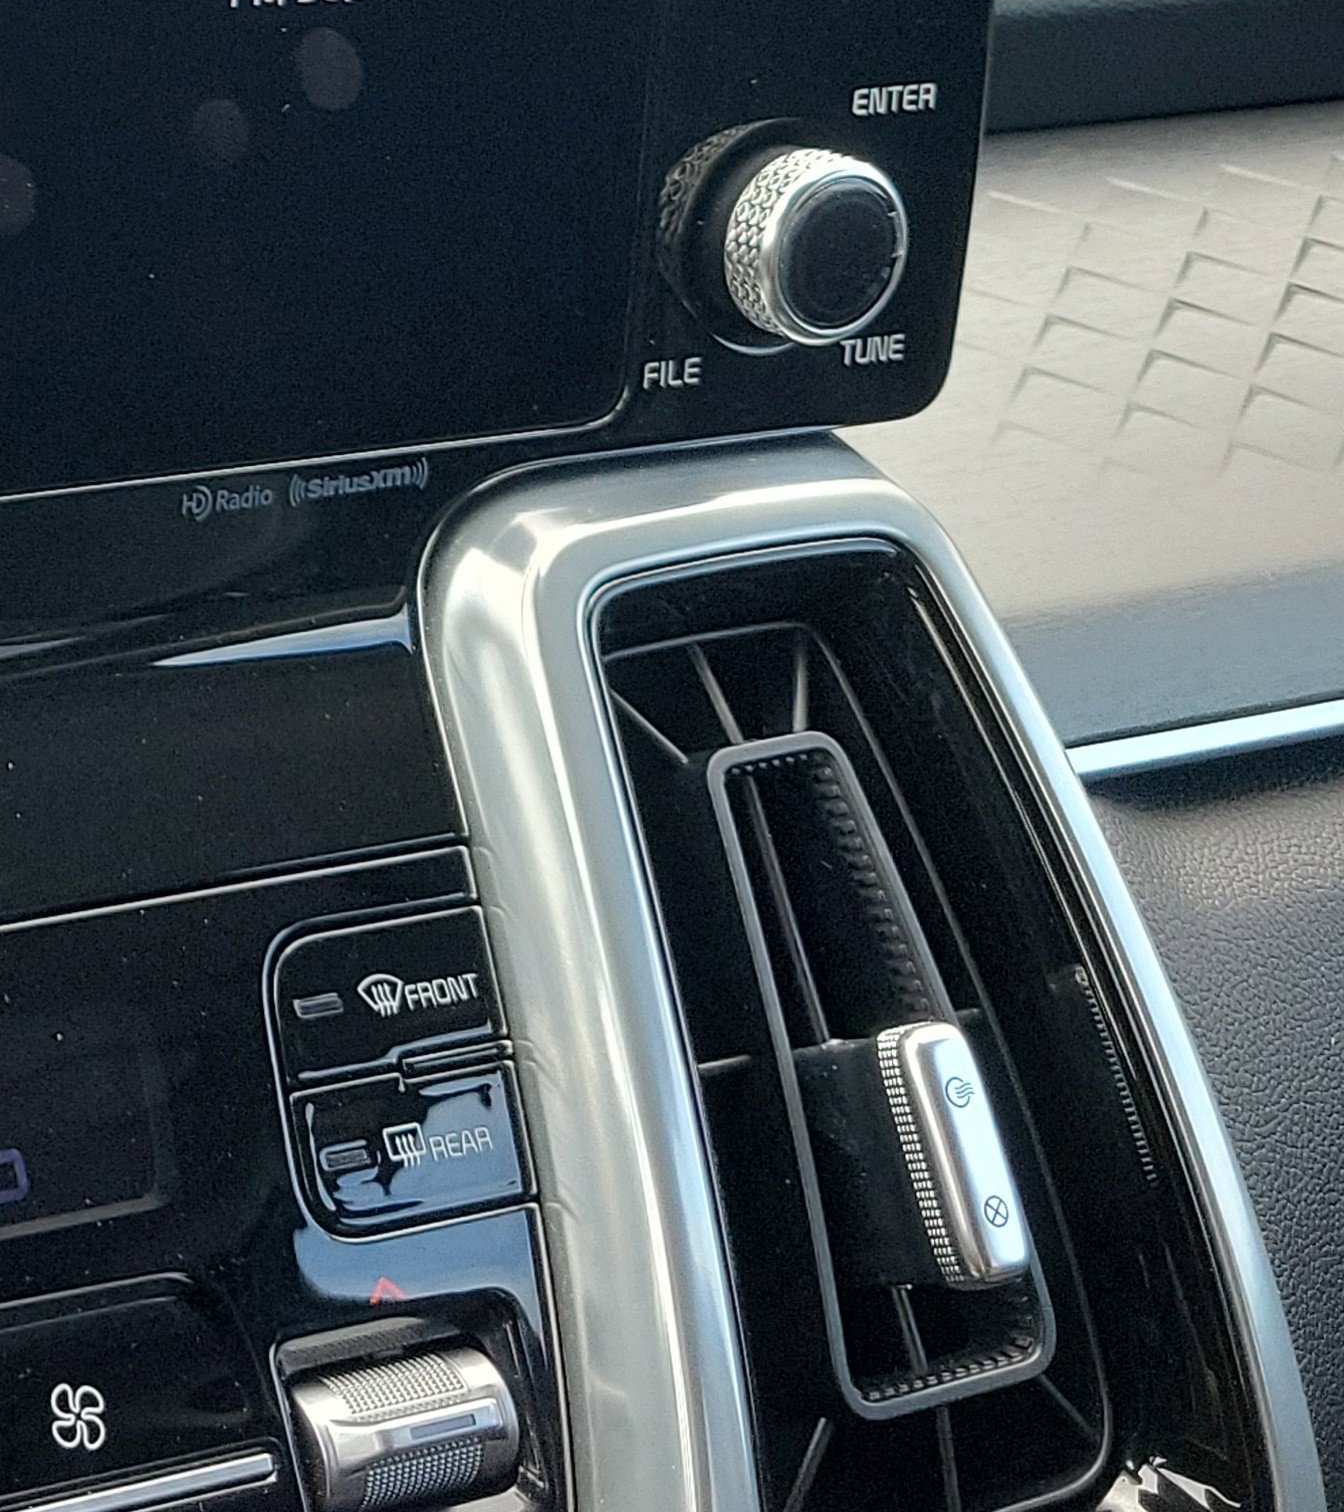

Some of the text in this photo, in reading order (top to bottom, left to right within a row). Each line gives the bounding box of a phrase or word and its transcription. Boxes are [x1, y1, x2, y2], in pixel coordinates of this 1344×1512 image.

[851, 82, 937, 116] ENTER
[839, 332, 905, 366] TUNE
[642, 356, 701, 390] FILE
[215, 485, 274, 513] Radio
[404, 972, 478, 1011] FRONT
[428, 1126, 494, 1162] REAR
